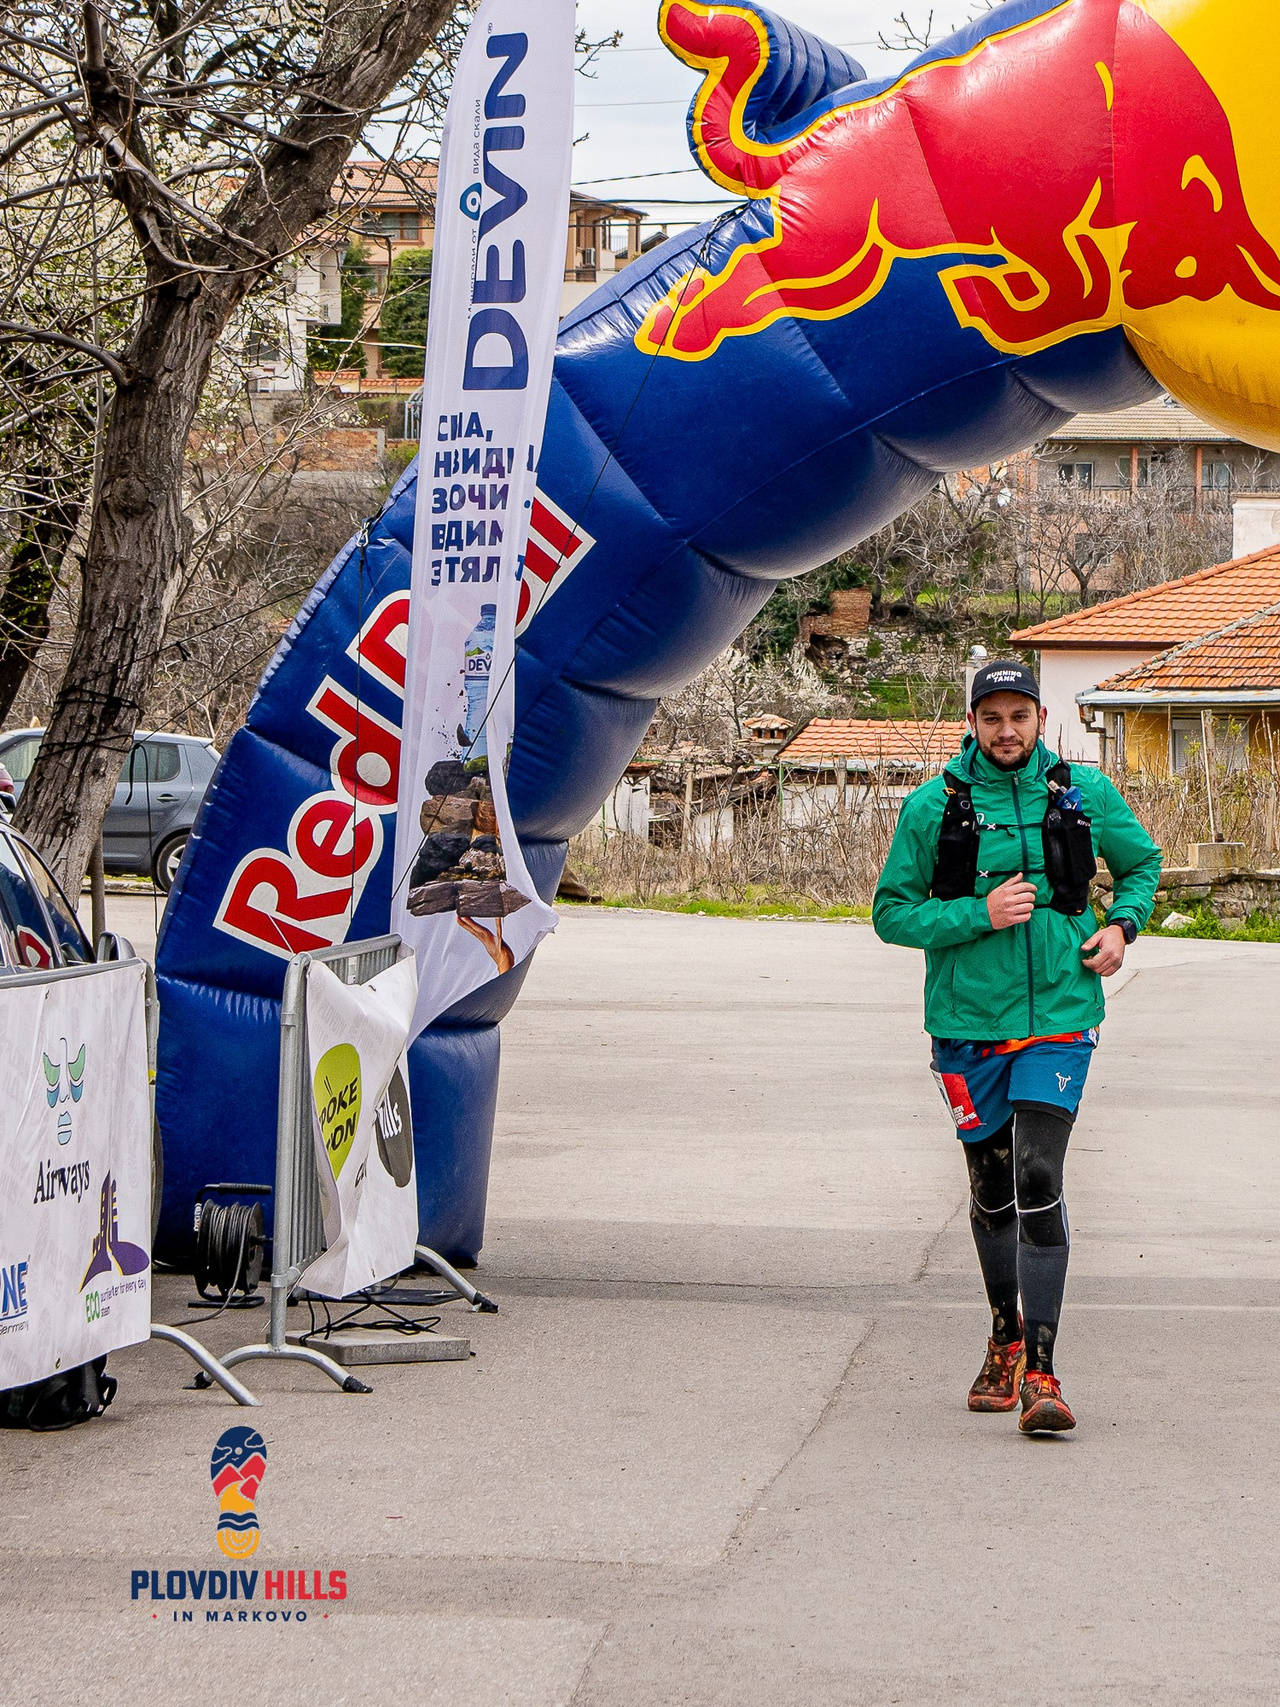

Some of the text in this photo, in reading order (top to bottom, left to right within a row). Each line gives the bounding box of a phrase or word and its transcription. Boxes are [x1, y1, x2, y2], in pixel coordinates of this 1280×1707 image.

[468, 658, 492, 672] DEV
[985, 669, 1022, 681] RUNNING
[993, 675, 1016, 683] TANK
[33, 1158, 90, 1204] Airways
